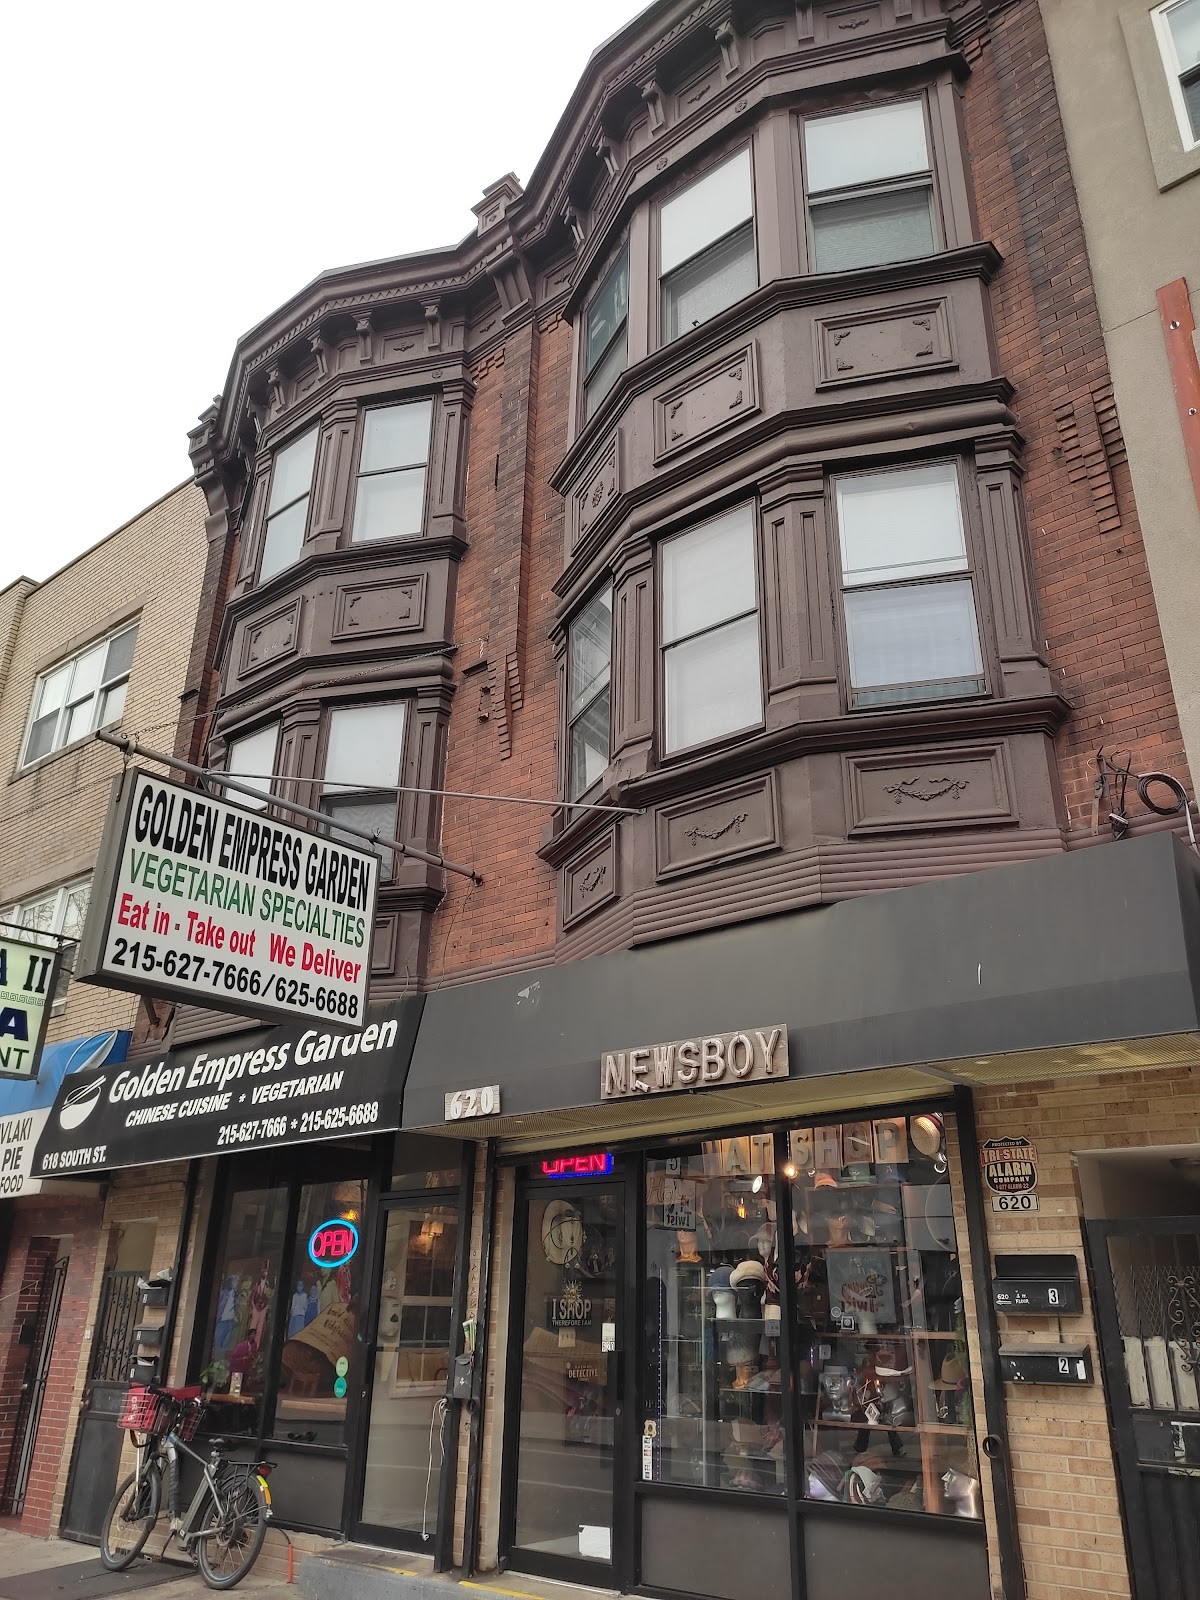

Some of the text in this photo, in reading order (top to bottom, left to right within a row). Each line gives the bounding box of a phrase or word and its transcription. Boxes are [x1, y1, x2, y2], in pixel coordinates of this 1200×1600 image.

[135, 785, 370, 911] GOLDEN EMPRESS GARDEN
[130, 848, 365, 948] VEGETARIAN SPECIALTIES
[117, 893, 150, 931] Eat
[153, 903, 170, 936] in
[187, 911, 225, 949] Take
[229, 929, 256, 957] out
[269, 932, 296, 967] We
[301, 943, 362, 984] Deliver
[108, 1062, 185, 1103] Golden
[185, 1042, 288, 1091] Empress
[604, 1029, 782, 1094] NEWSBOY
[125, 1071, 344, 1128] CHINESE CUISINE VEGETARIAN
[450, 1086, 494, 1119] 620
[217, 1101, 379, 1146] 215-627-7666 215-625-6688
[42, 1145, 107, 1170] 618 SOUTH ST.
[792, 1121, 899, 1166] SHOP
[982, 1147, 1035, 1163] TRI-STATE
[1, 1146, 23, 1172] PIE
[542, 1154, 606, 1173] OPEN
[989, 1162, 1032, 1177] ALARM
[0, 1174, 24, 1194] FOOD
[999, 1196, 1031, 1210] 620
[312, 1229, 353, 1257] OPEN
[552, 1299, 592, 1319] I SHOP
[568, 1368, 599, 1378] DETECTIVE
